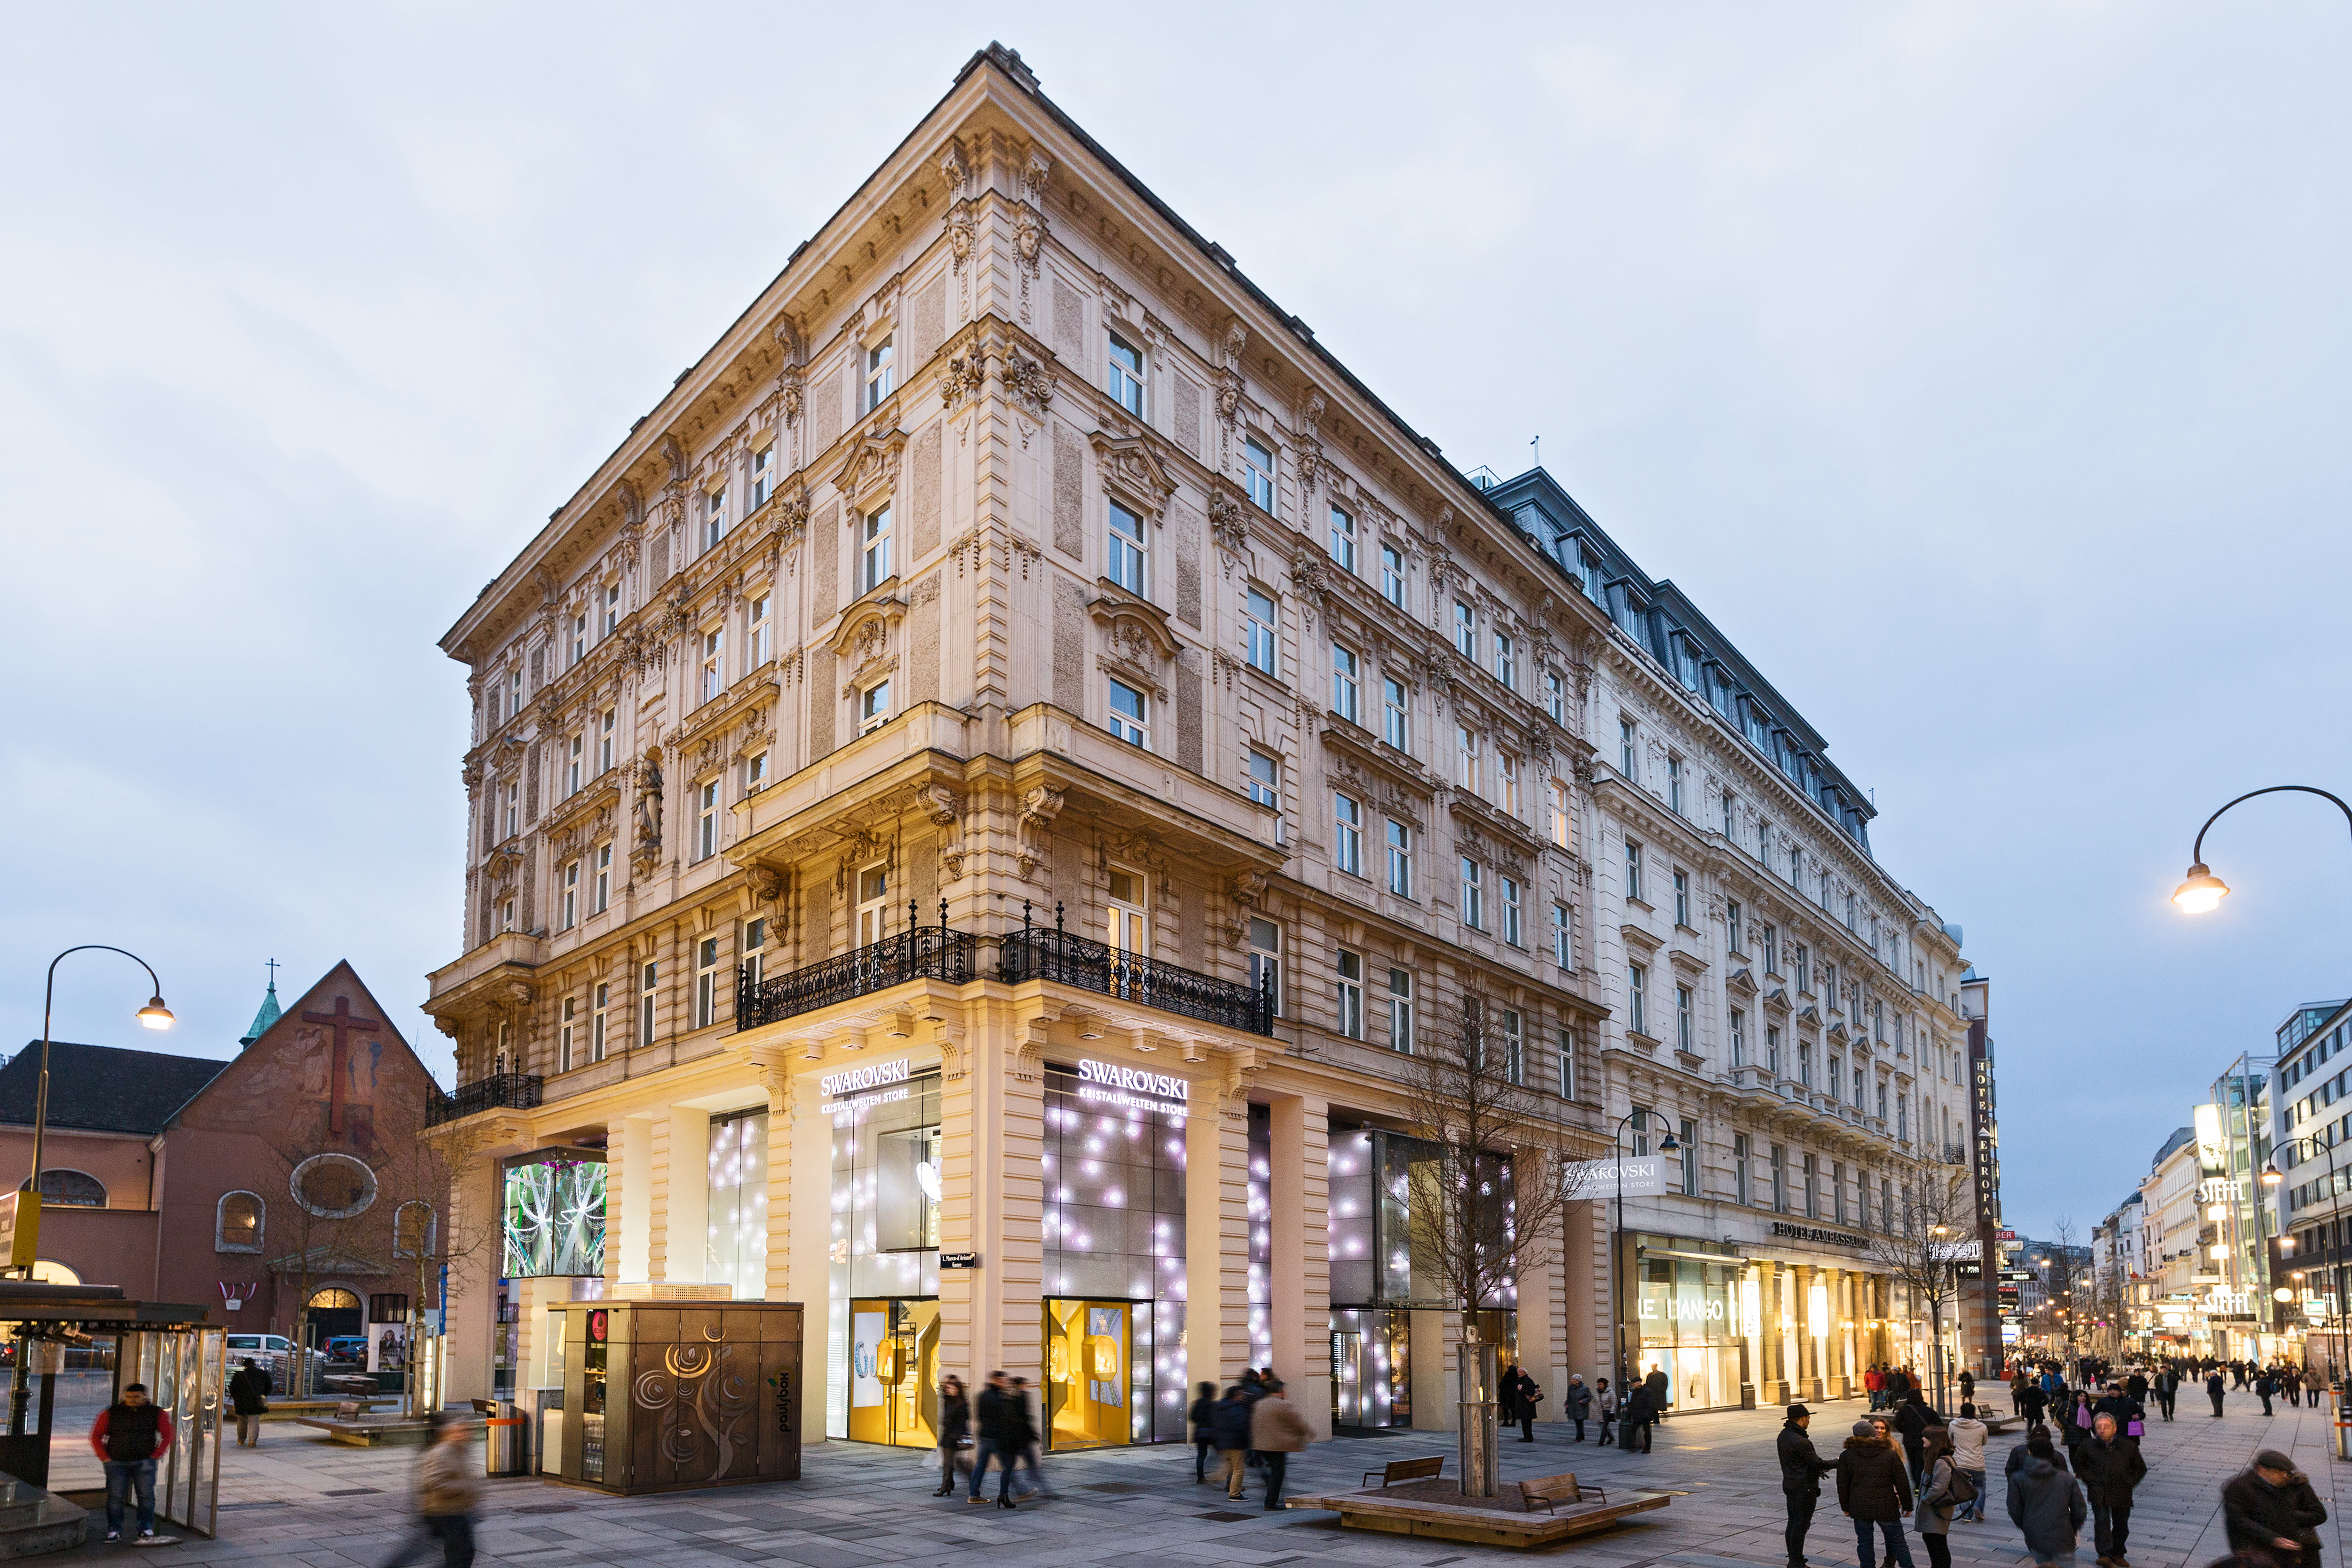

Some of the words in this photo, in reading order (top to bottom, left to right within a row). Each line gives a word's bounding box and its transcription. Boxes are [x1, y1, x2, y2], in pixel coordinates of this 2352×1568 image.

[821, 1059, 909, 1097] SWAROVSKI
[1079, 1059, 1188, 1099] SWAROVSKI
[1977, 1062, 1986, 1123] HOTEL
[821, 1094, 881, 1114] KRISTALLWELTEN
[883, 1088, 908, 1103] STORE
[1079, 1087, 1158, 1111] KRISTALLWELTEN
[1160, 1103, 1188, 1117] STORE
[1980, 1140, 1991, 1215] EUROPA
[2199, 1180, 2245, 1202] STEFFL
[1779, 1222, 1812, 1240] HOTEL
[1815, 1228, 1869, 1249] AMBASSADOR
[2204, 1293, 2251, 1313] STEFFL
[776, 1372, 792, 1432] paulsbox
